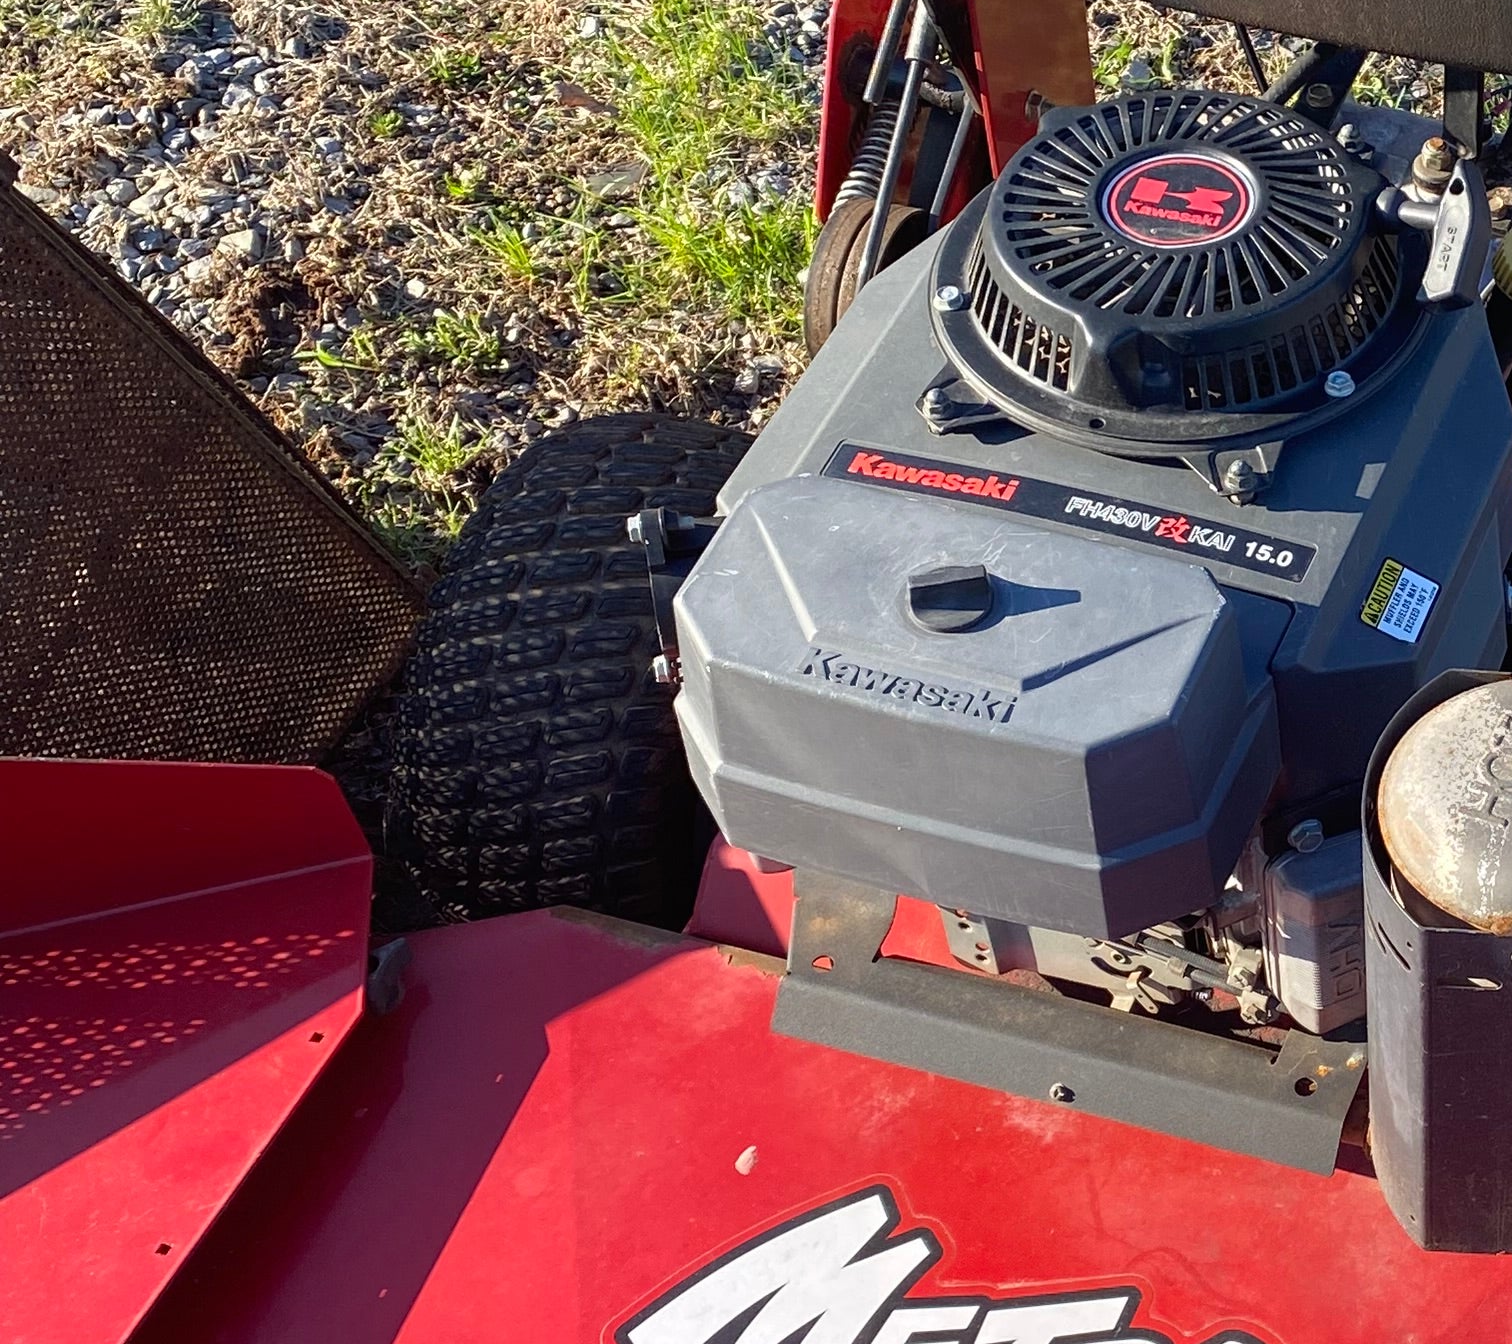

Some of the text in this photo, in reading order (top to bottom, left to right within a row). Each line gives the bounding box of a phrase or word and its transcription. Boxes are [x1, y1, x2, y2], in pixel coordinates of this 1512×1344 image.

[1123, 199, 1223, 228] Kawasaki
[1436, 226, 1458, 272] START
[846, 451, 1020, 502] Kawasaki
[1244, 540, 1294, 568] 15.0
[1368, 563, 1400, 614] CAUTION
[1383, 577, 1410, 624] MUFFLER AND
[1394, 583, 1419, 629] SHIELDS MAY
[1403, 607, 1421, 634] EXCEED
[797, 646, 1018, 724] Kawasaki
